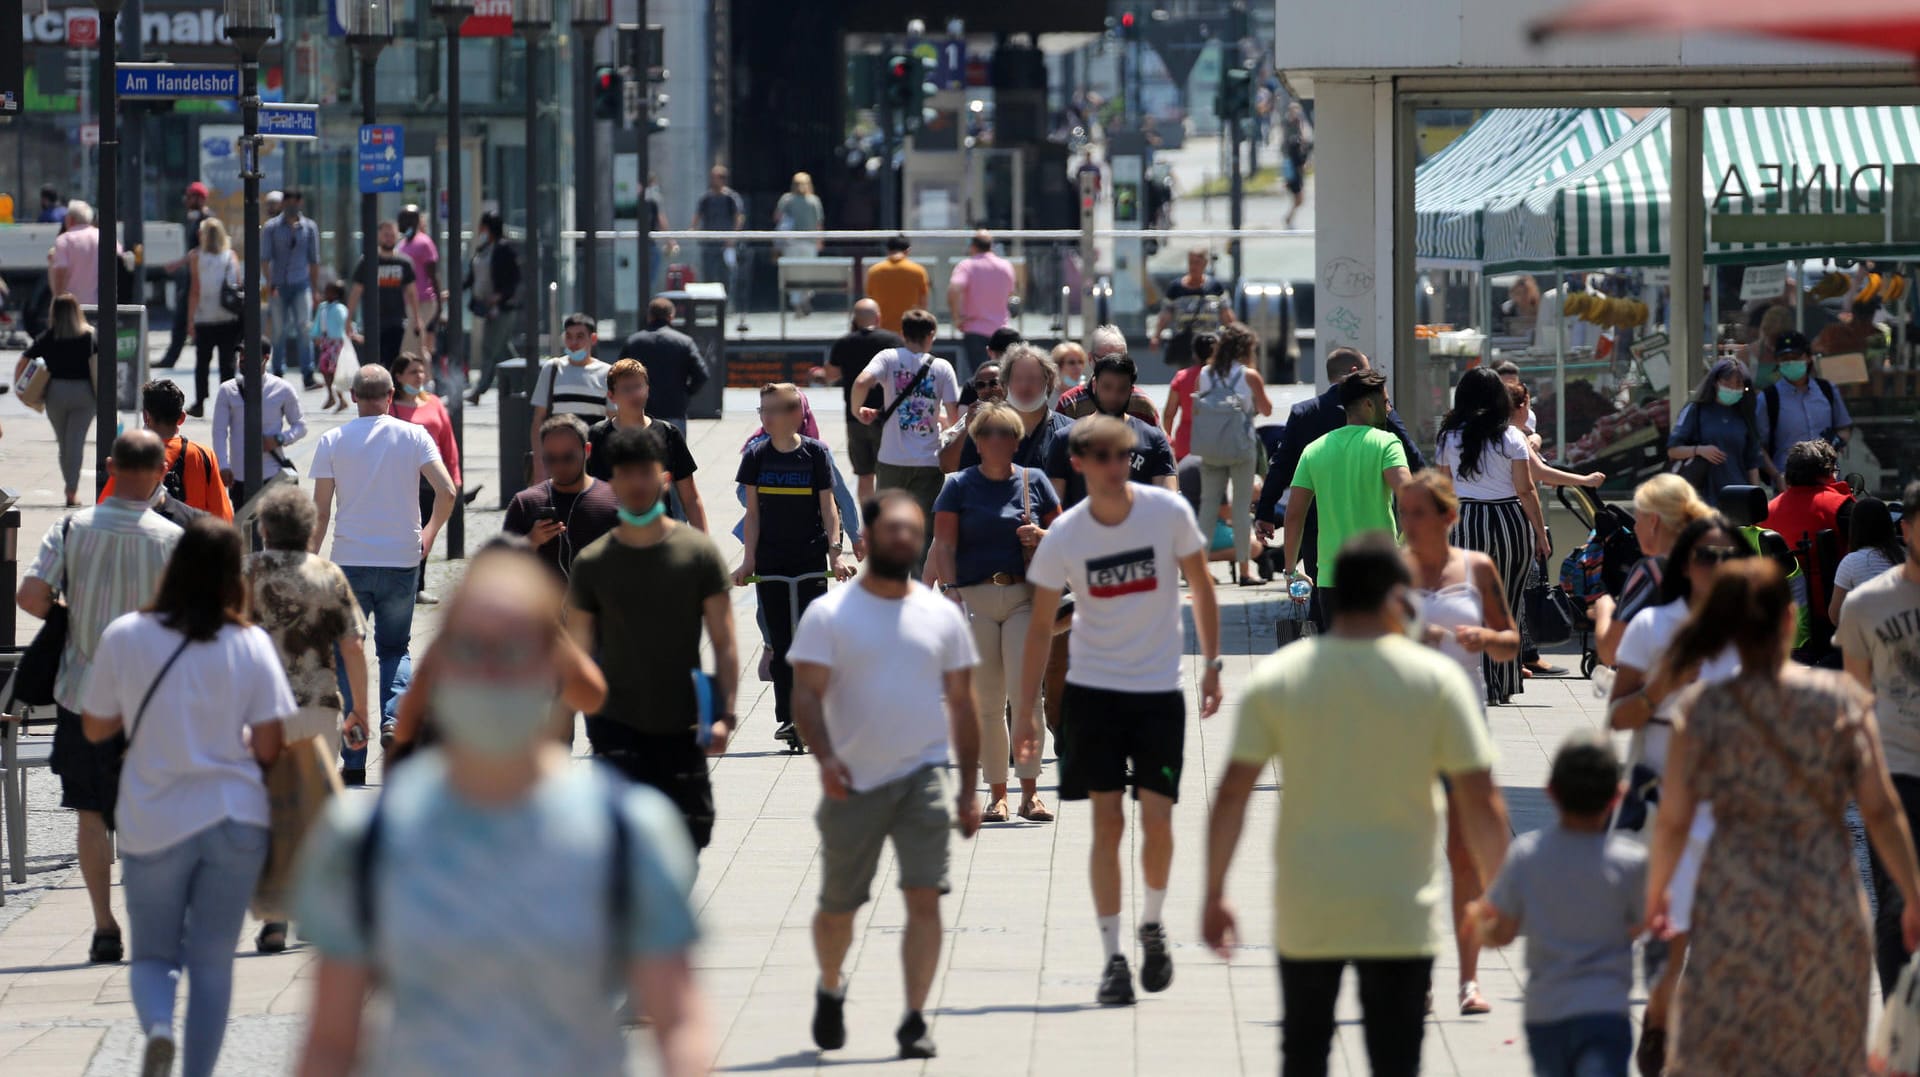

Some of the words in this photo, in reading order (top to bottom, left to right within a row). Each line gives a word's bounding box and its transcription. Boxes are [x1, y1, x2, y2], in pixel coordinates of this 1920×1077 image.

[126, 73, 148, 91] Am
[156, 73, 235, 91] Handelshof
[759, 471, 811, 486] REVIEW
